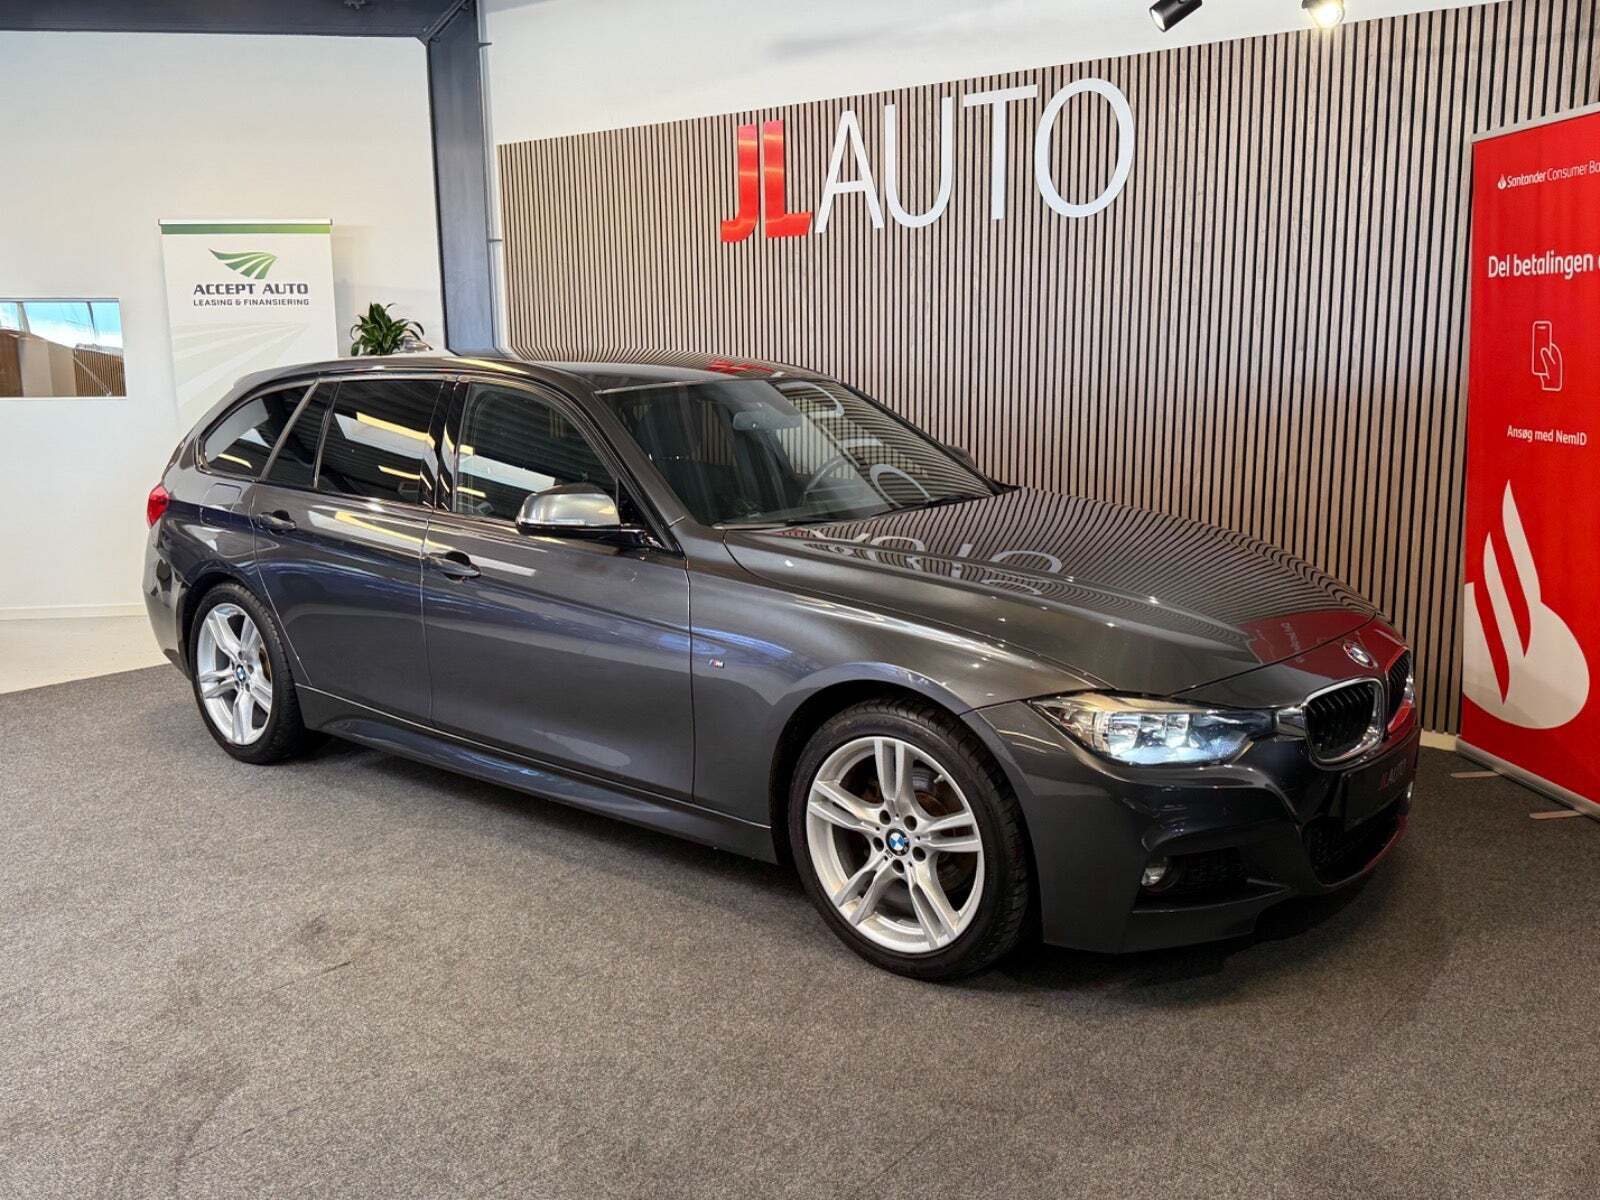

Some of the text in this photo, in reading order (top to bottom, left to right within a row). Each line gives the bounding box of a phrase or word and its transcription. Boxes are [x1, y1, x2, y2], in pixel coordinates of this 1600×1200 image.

[1507, 171, 1546, 188] Santander
[1547, 164, 1588, 181] Consumer
[1488, 254, 1510, 278] Del
[1513, 250, 1594, 280] betalingen
[193, 284, 309, 295] ACCEPT AUTO
[1507, 425, 1587, 446] Ansøg med NemID
